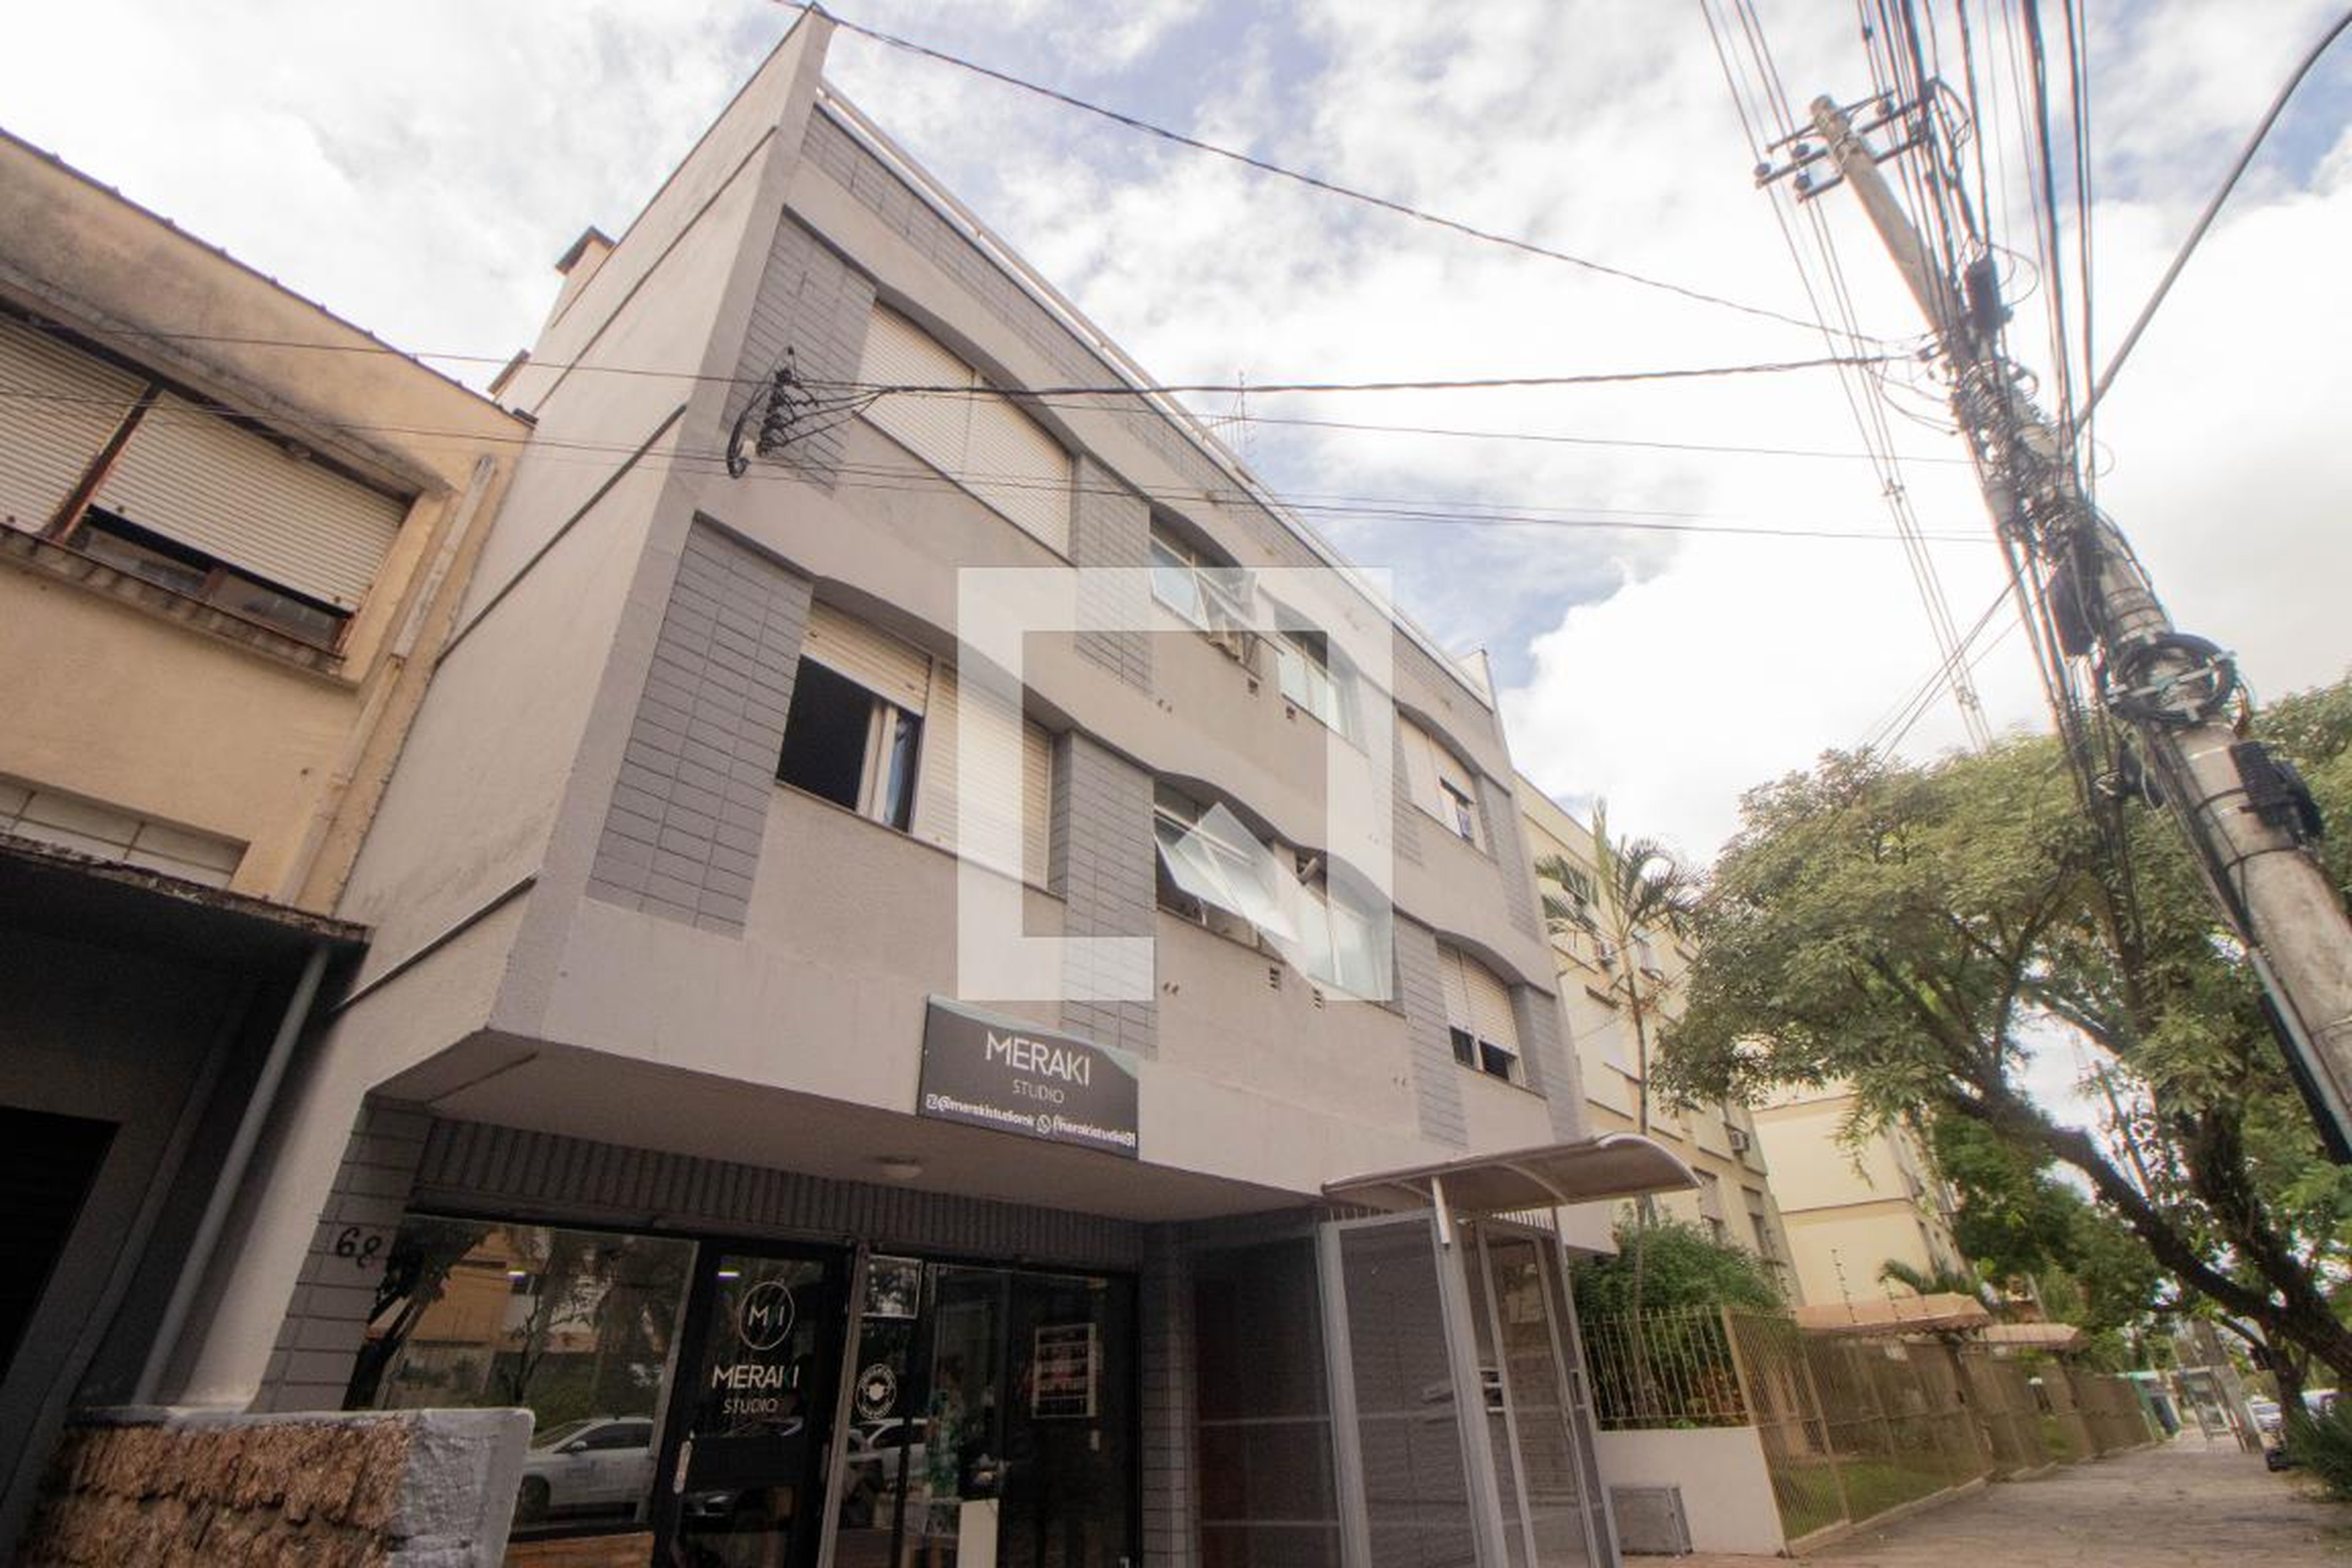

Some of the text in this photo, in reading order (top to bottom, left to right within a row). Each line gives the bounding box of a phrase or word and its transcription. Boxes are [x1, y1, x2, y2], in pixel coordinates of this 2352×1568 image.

[986, 1031, 1090, 1087] MERAKI
[1012, 1079, 1065, 1103] STUDIO
[723, 1398, 778, 1414] STUDIO
